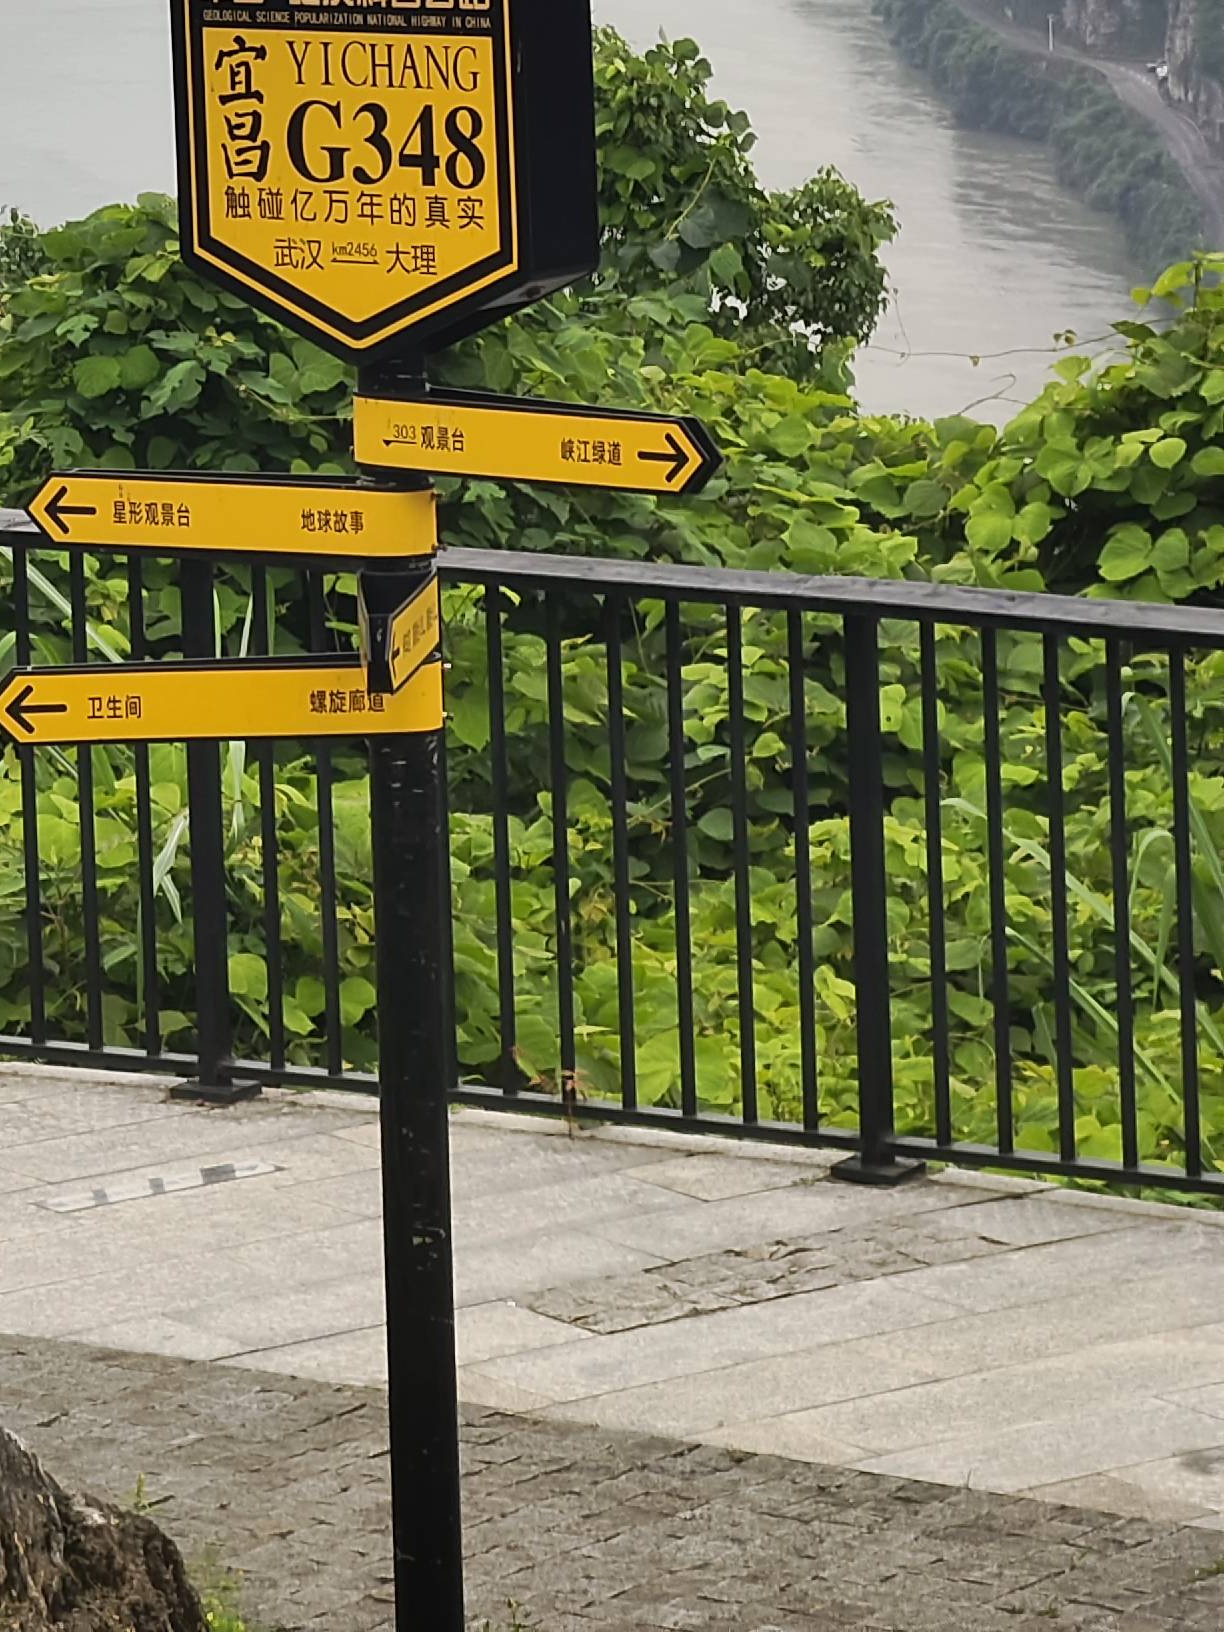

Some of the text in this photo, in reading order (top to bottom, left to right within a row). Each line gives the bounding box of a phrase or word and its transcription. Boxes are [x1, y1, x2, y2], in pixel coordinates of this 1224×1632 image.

[203, 9, 492, 29] GEOLOGICAL SCIENCE POPULARIZATION NATIONAL HIGHWAY IN CHINA
[285, 40, 480, 93] YICHANG
[215, 35, 271, 183] 宜昌
[286, 99, 486, 190] G348
[224, 185, 485, 231] 触碰亿万年的真实
[273, 237, 438, 276] 武汉 km2456 大理
[393, 424, 466, 453] 303 观景台
[560, 437, 623, 466] 峡江绿道
[113, 500, 191, 528] 星形观景台
[300, 508, 365, 536] 地球故事
[86, 695, 143, 720] 卫生间
[309, 689, 386, 714] 螺旋廊道
